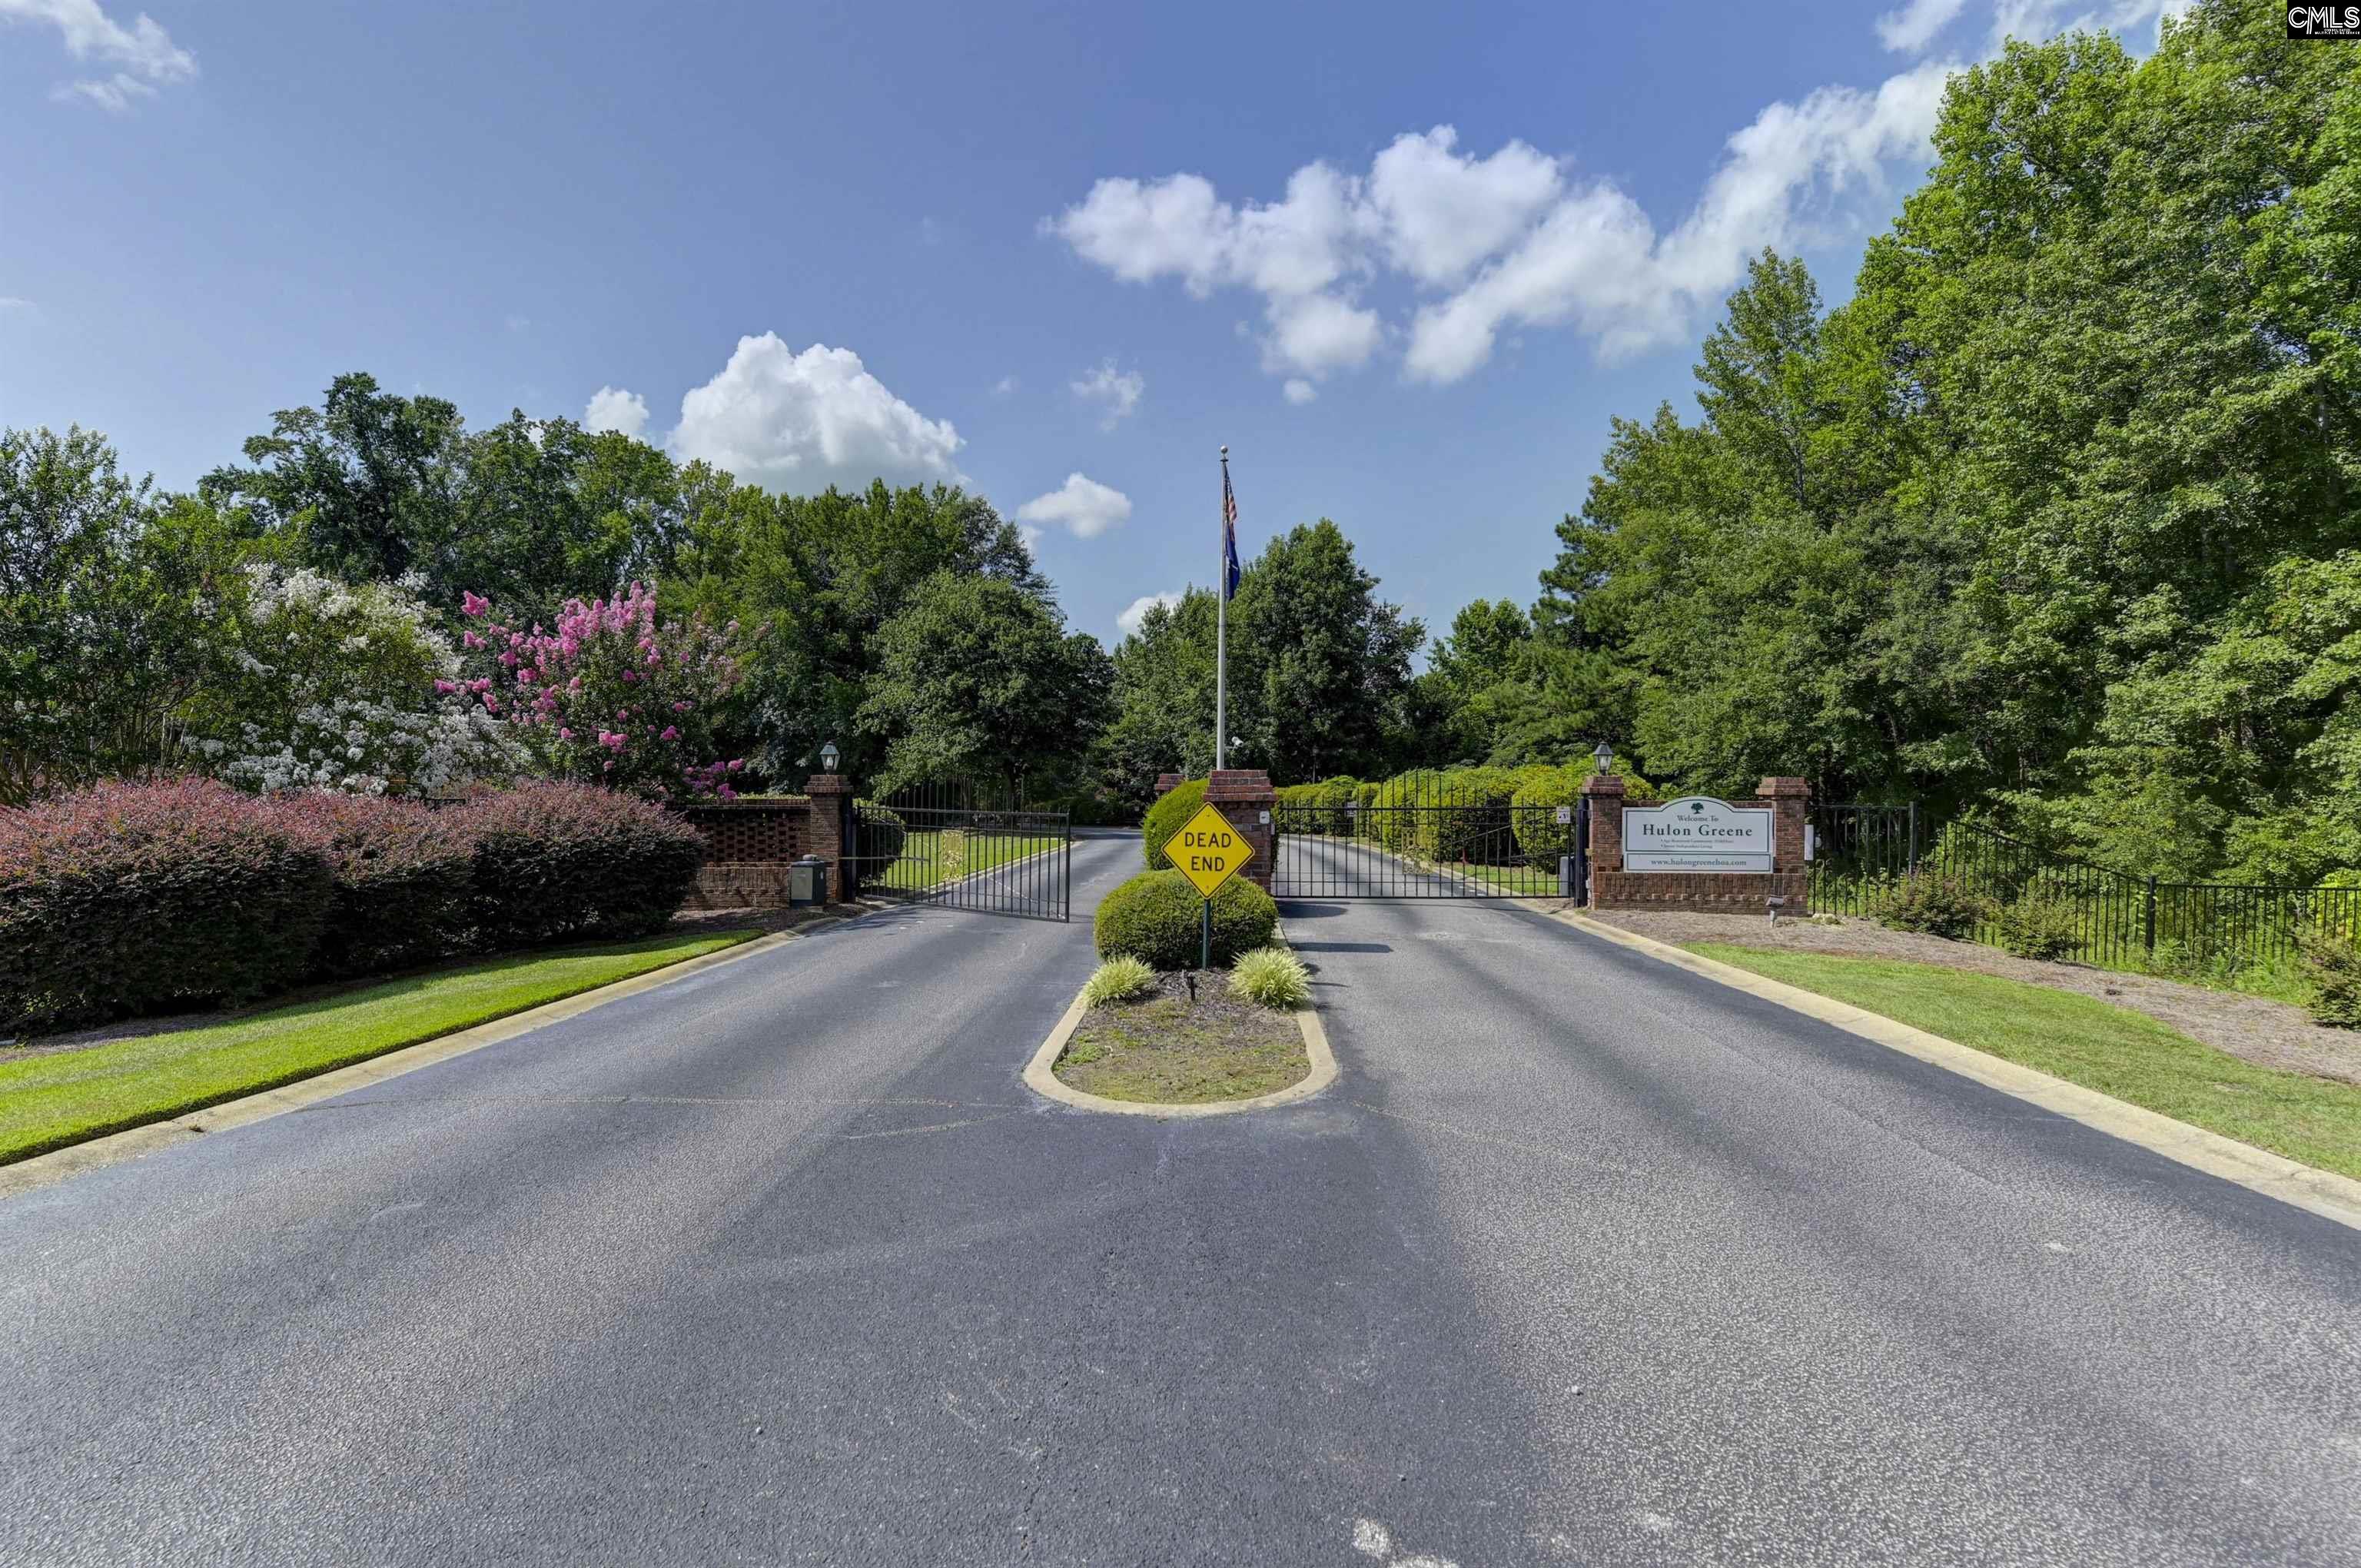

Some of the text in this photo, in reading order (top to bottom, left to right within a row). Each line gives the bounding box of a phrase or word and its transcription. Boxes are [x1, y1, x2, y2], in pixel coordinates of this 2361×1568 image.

[1642, 824, 1753, 837] Hulon Greene
[1184, 832, 1231, 848] DEAD
[1191, 856, 1225, 872] END
[1651, 858, 1747, 867] www.hulongreenehoa.com
